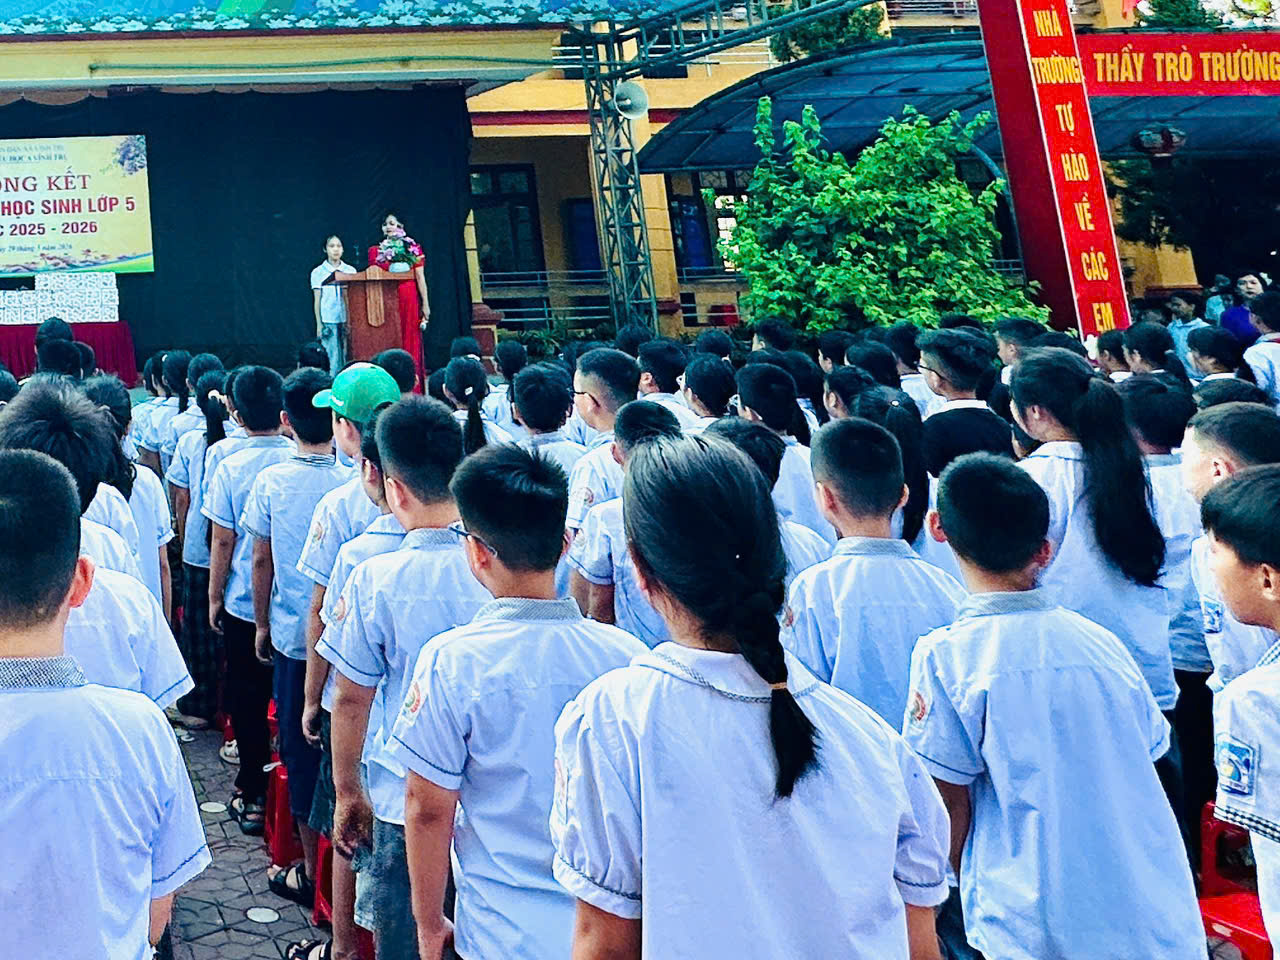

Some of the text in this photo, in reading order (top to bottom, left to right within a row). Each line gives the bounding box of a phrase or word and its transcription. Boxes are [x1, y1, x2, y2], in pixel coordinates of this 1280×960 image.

[1033, 7, 1063, 38] NHÀ
[1032, 50, 1082, 84] TRƯỜNG
[1093, 43, 1280, 82] THẦY TRÒ TRƯỜNG
[1055, 101, 1075, 137] TỰ
[47, 165, 92, 191] KẾT
[1061, 153, 1090, 182] HÀO
[0, 199, 36, 219] HỌC
[41, 197, 82, 215] SINH
[88, 193, 120, 213] LỚP
[124, 196, 136, 212] 5
[1074, 192, 1095, 232] VỀ
[9, 223, 46, 236] 2025
[61, 221, 98, 235] 2026
[1081, 247, 1110, 281] CÁC
[1092, 302, 1116, 333] EM
